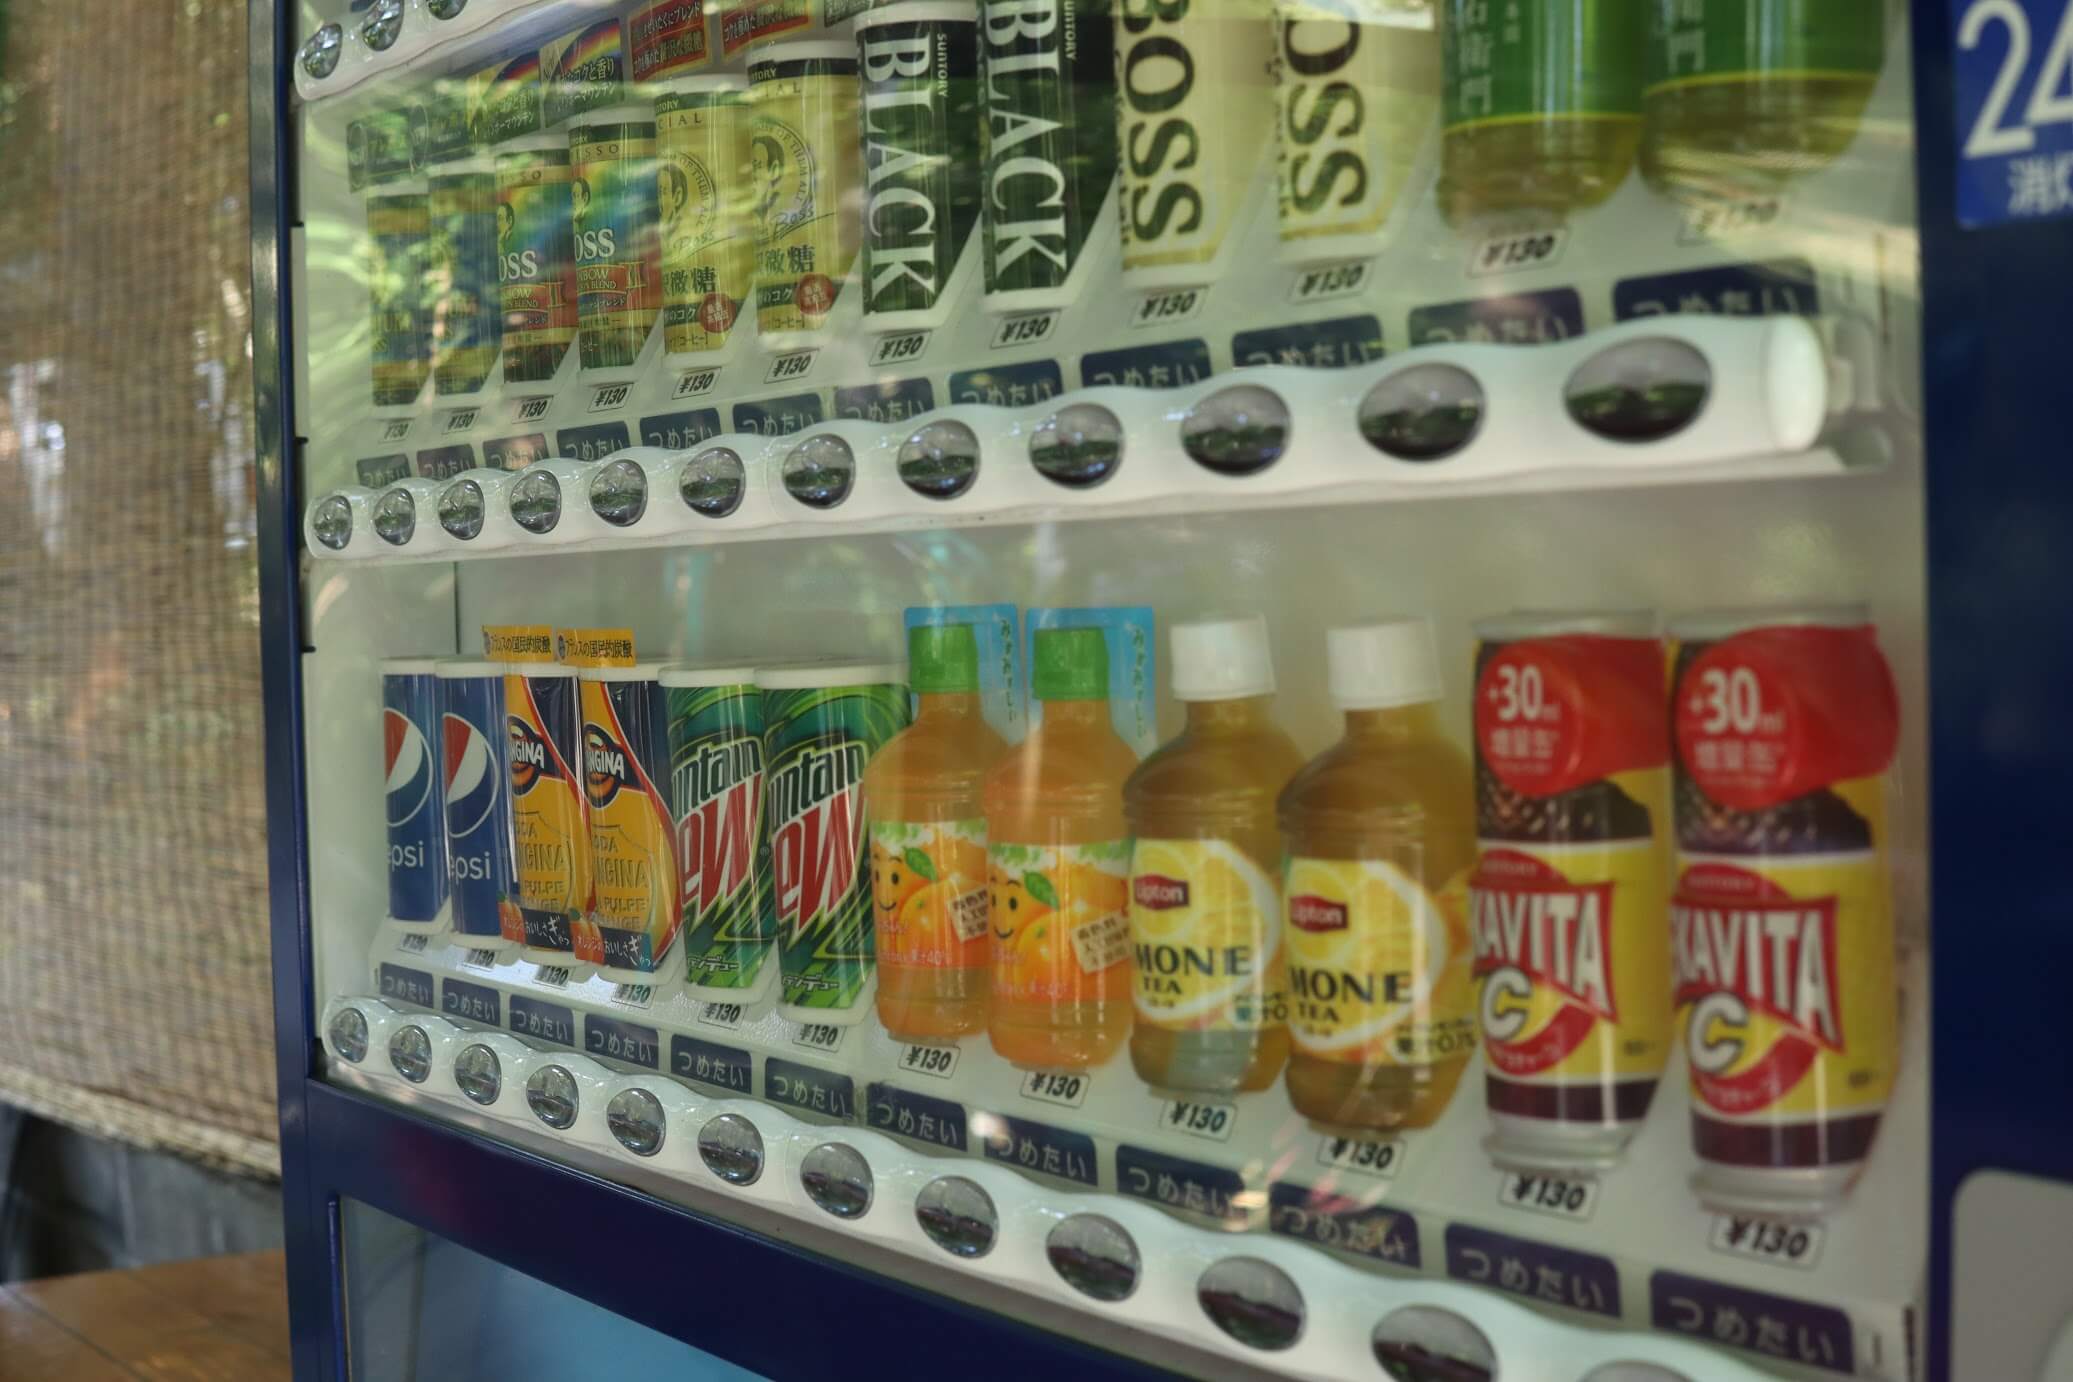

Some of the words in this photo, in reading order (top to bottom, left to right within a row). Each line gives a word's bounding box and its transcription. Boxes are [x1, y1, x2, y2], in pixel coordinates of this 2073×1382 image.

[936, 33, 949, 98] SUNTORY
[985, 0, 1067, 282] BLACK
[863, 31, 937, 310] BLACK
[1483, 234, 1556, 266] ¥130
[1302, 265, 1364, 295] ¥130
[1142, 293, 1197, 319] ¥130
[1001, 316, 1051, 343] ¥130
[878, 335, 924, 360] ¥130
[771, 355, 812, 378] ¥130
[594, 386, 628, 407] ¥130
[679, 372, 714, 394] ¥130
[960, 381, 1054, 407] つめたい
[448, 411, 476, 430] ¥130
[517, 399, 548, 418] ¥130
[845, 400, 925, 423] つめたい
[649, 426, 714, 450] つめたい
[742, 413, 817, 437] つめたい
[565, 438, 625, 461] つめたい
[465, 949, 496, 968] ¥130
[383, 975, 430, 1002] つめたい
[538, 965, 570, 986] ¥130
[1143, 975, 1183, 995] TEA
[616, 983, 651, 1002] ¥130
[1482, 965, 1533, 1042] C
[446, 992, 497, 1022] つめたい
[704, 1003, 741, 1024] ¥130
[1298, 1002, 1341, 1023] TEA
[514, 1009, 569, 1041] つめたい
[799, 1023, 839, 1046] ¥130
[1688, 990, 1750, 1074] C
[591, 1029, 652, 1063] つめたい
[906, 1045, 952, 1072] ¥130
[678, 1051, 745, 1087] つめたい
[773, 1075, 847, 1116] つめたい
[1030, 1073, 1081, 1099] ¥130
[876, 1102, 958, 1145] つめたい
[1169, 1101, 1227, 1133] ¥130
[998, 1134, 1087, 1179] つめたい
[1330, 1136, 1396, 1169] ¥130
[1513, 1174, 1587, 1212] ¥130
[1725, 1217, 1809, 1258] ¥130
[1460, 1247, 1607, 1309] つめたい
[1670, 1295, 1835, 1363] つめたい
